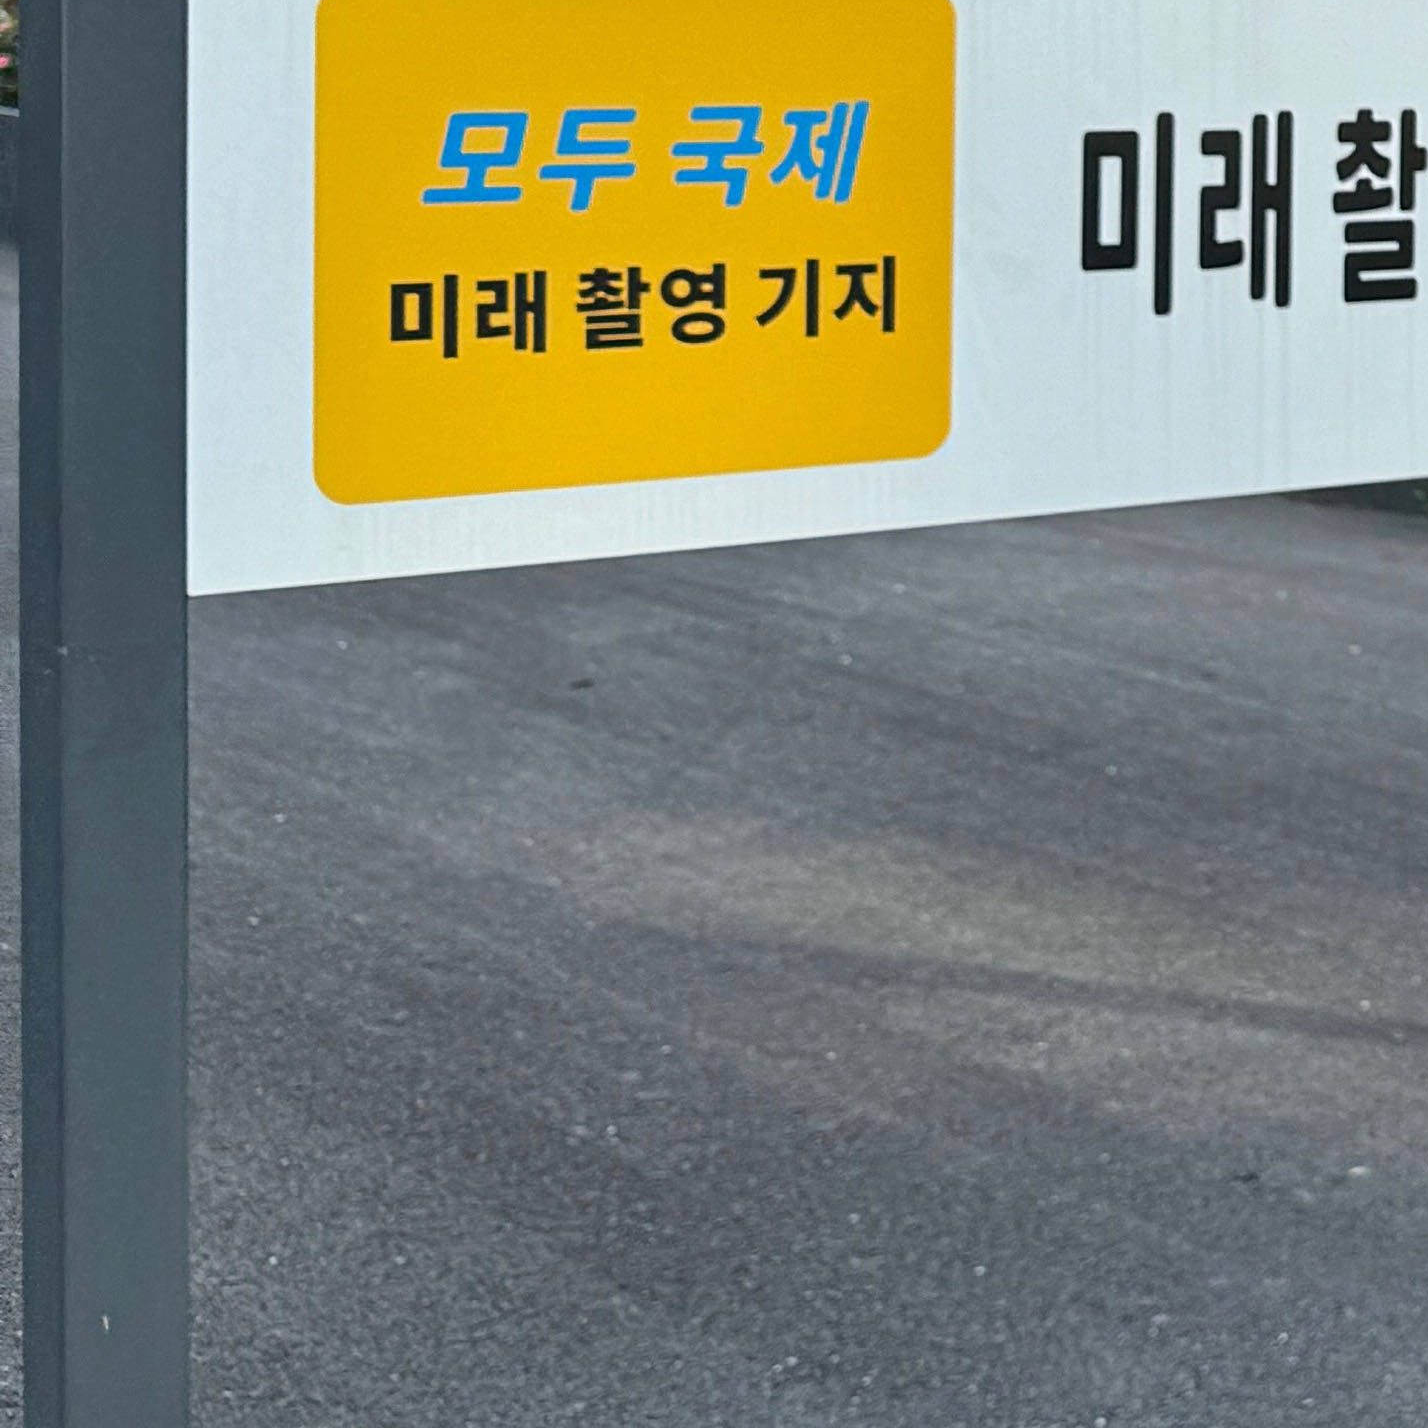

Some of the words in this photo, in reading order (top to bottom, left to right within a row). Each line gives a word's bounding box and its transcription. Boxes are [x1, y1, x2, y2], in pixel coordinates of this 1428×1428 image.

[423, 110, 635, 210] 모두
[672, 102, 868, 206] 국제
[1082, 111, 1293, 315] 미래
[391, 271, 546, 358] 미래
[576, 263, 725, 349] 촬영
[756, 256, 895, 337] 기지
